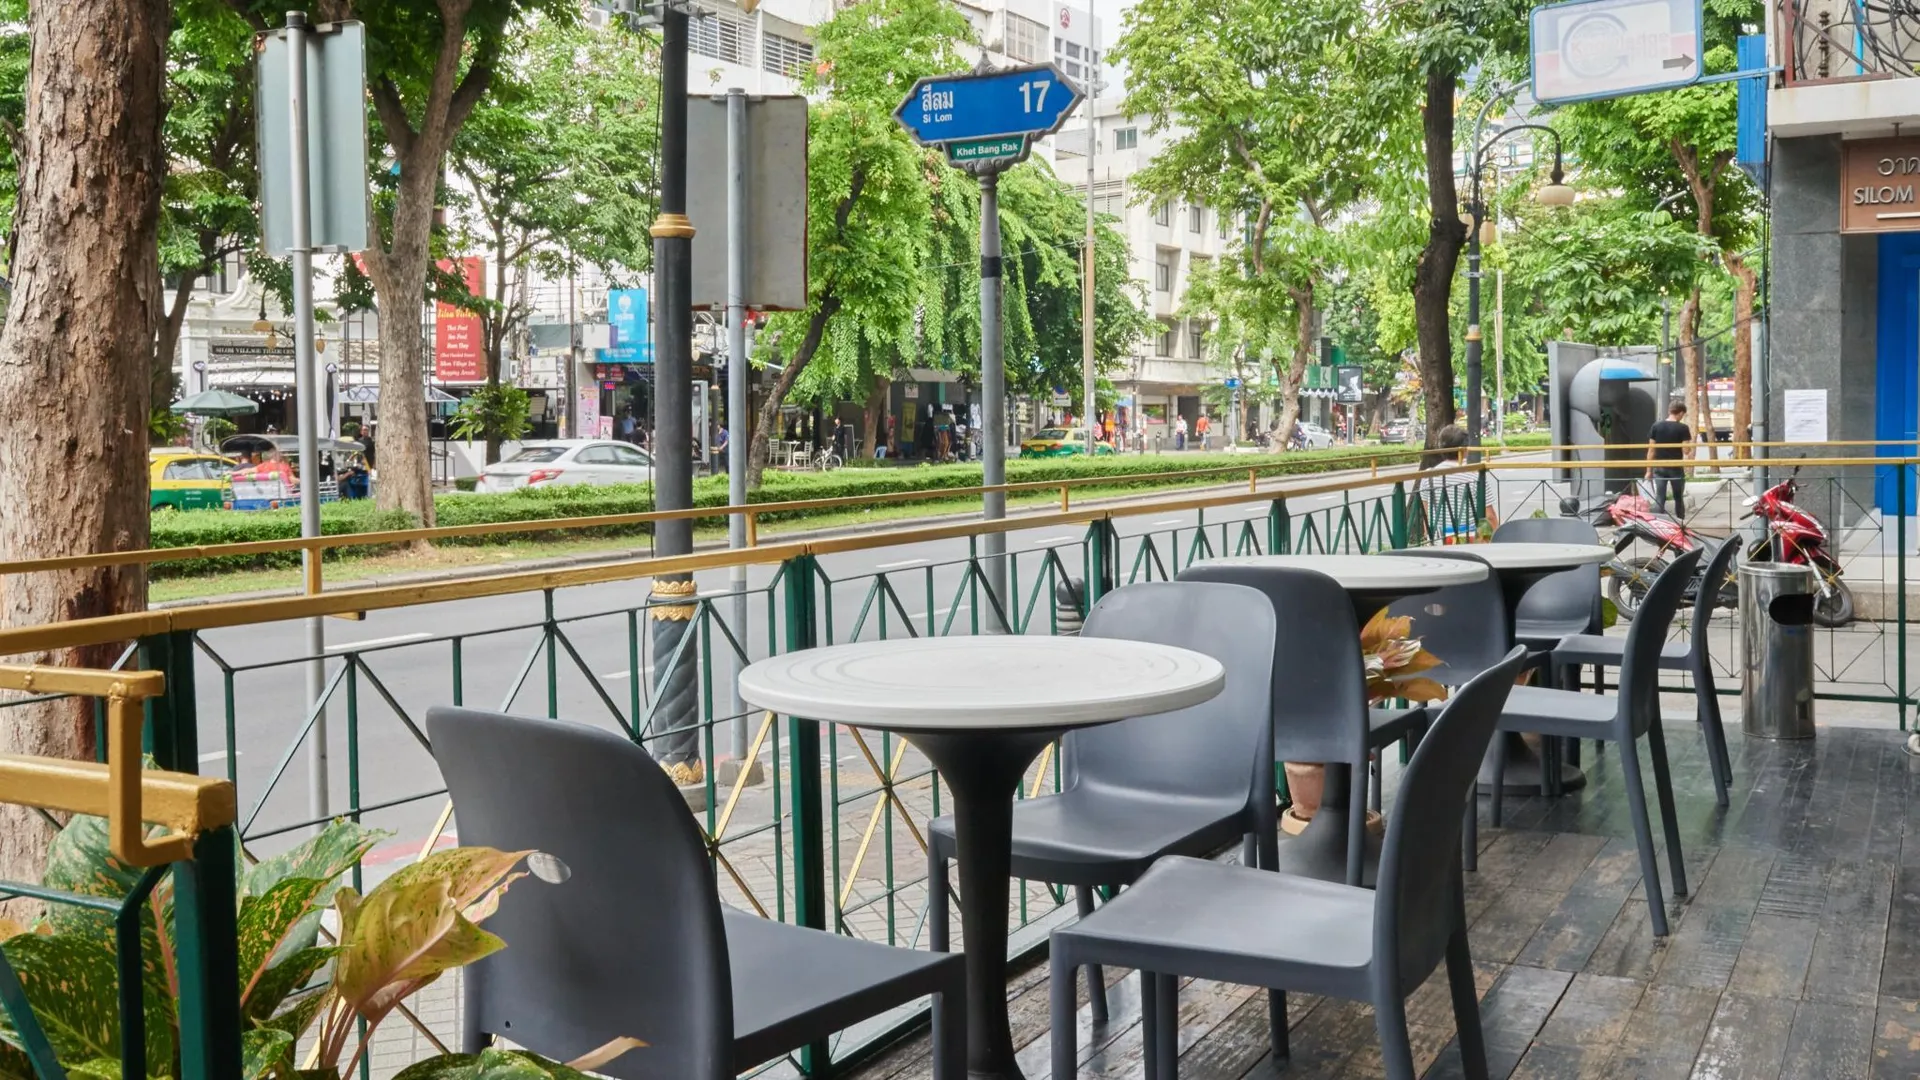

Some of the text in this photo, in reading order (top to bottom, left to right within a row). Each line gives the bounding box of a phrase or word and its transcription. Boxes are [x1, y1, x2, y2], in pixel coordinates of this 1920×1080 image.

[922, 84, 954, 112] สีลม
[1019, 80, 1050, 113] 17
[923, 113, 952, 123] Si Lom
[956, 143, 1018, 156] Khet Bang Rak
[1853, 185, 1913, 205] SILOM
